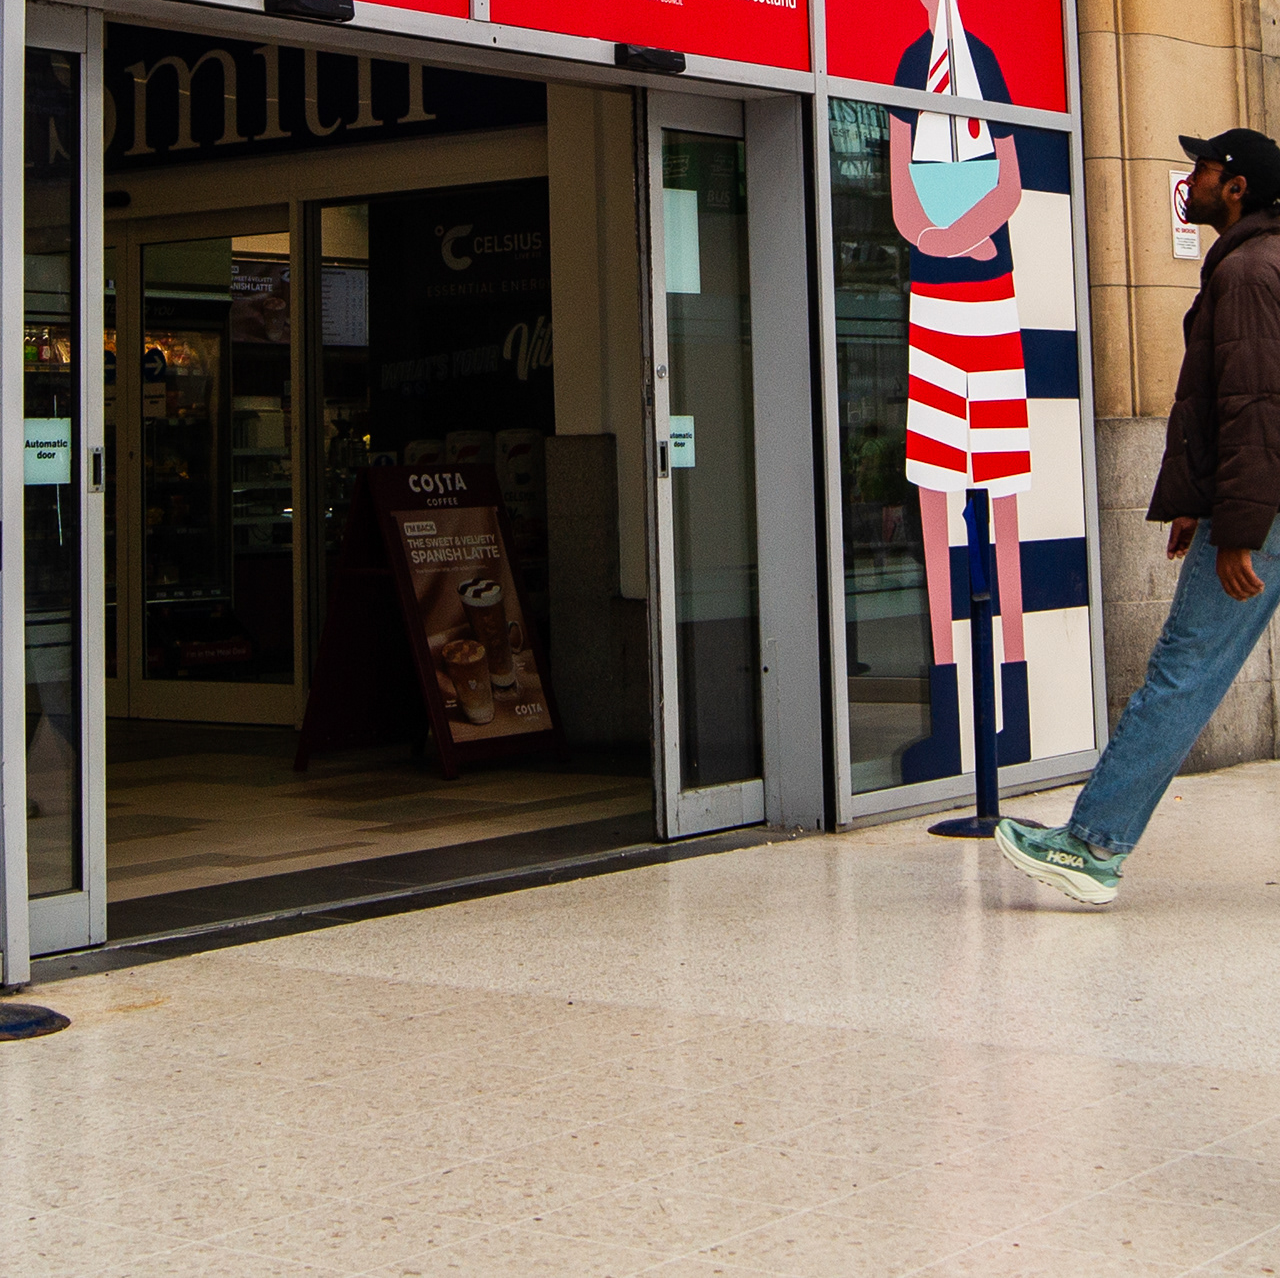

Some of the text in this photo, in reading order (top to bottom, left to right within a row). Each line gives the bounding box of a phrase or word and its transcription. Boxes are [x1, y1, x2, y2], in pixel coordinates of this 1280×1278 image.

[473, 232, 542, 254] CELSIUS
[25, 439, 68, 448] Automatic
[37, 451, 56, 459] door
[409, 472, 468, 494] COSTA
[426, 497, 459, 507] COFFEE
[425, 536, 454, 548] SWEET
[410, 545, 500, 564] SPANISH LATTE
[515, 703, 543, 715] COSTA
[1046, 850, 1084, 869] HOKA
